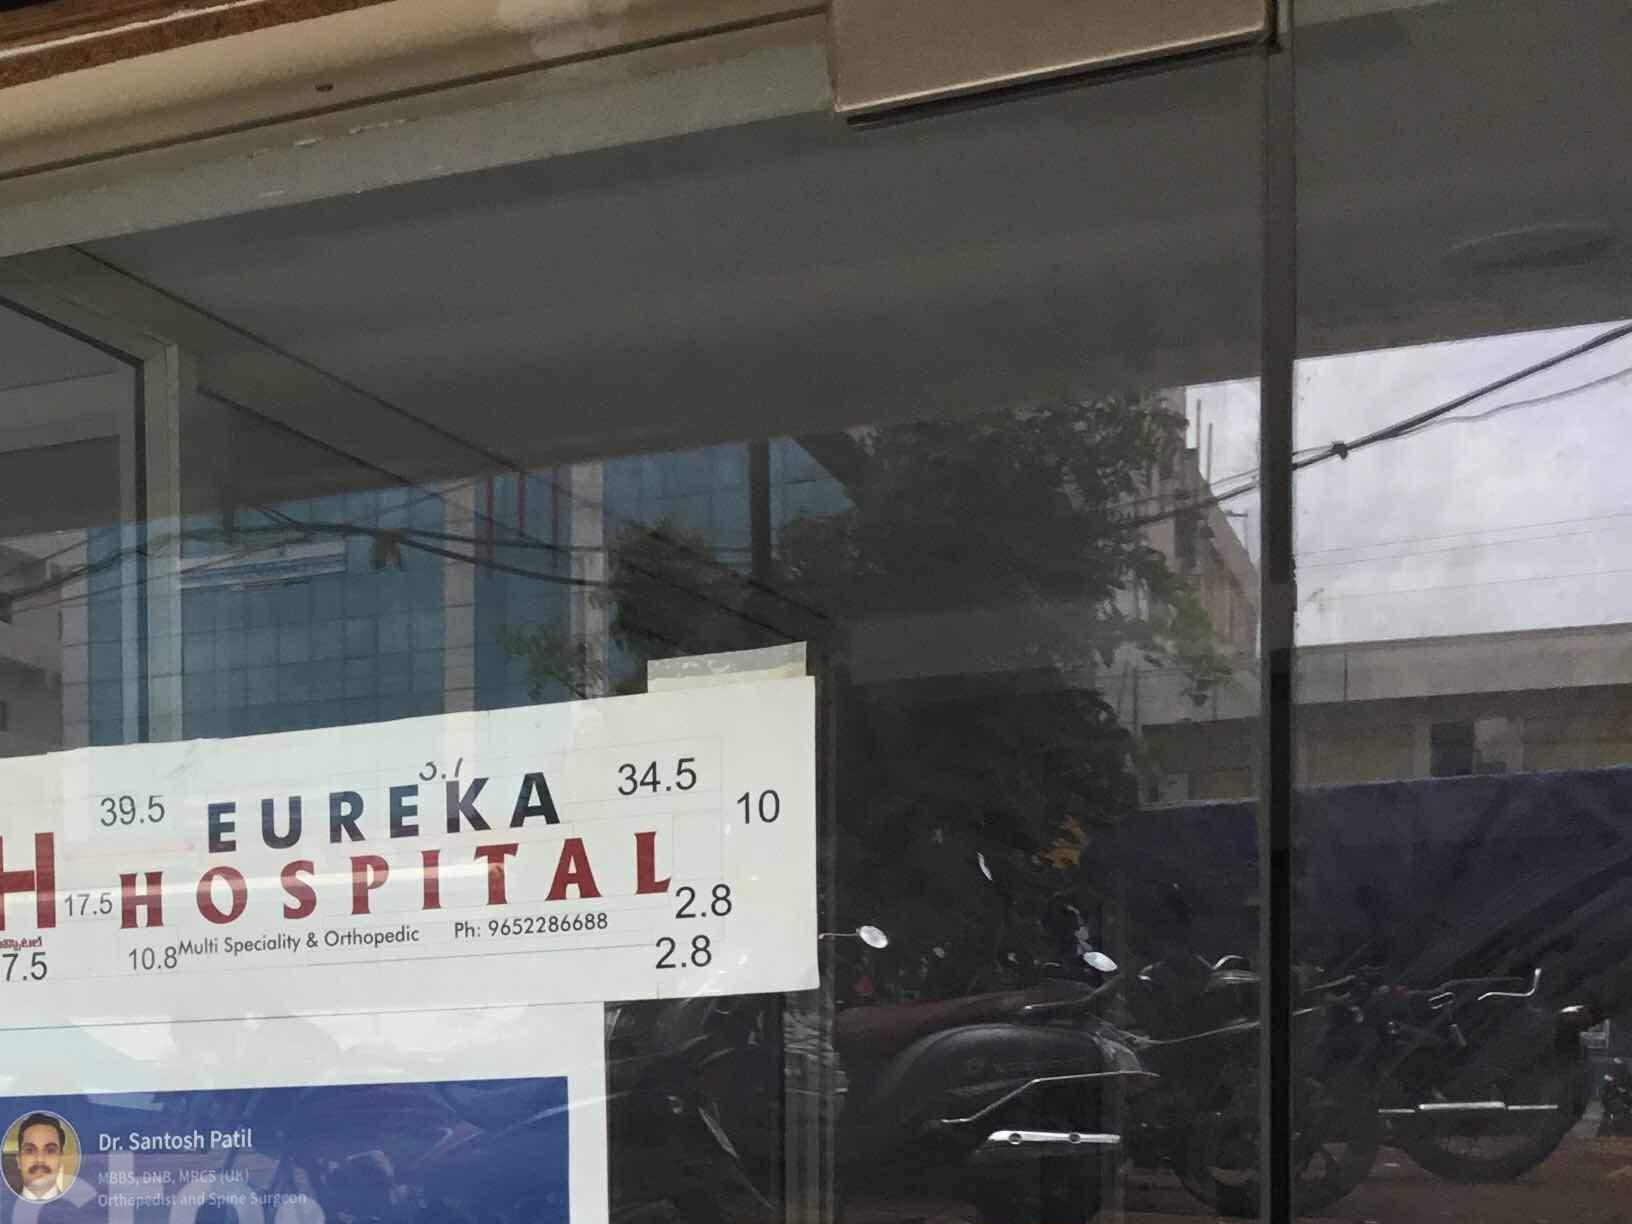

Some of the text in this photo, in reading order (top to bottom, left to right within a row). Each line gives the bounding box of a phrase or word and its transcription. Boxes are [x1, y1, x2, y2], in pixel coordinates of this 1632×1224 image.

[618, 757, 697, 796] 34.5
[100, 795, 166, 827] 39.5
[208, 772, 561, 853] EUREKA
[736, 790, 780, 824] 10
[119, 830, 672, 928] HOSPITAL
[65, 892, 113, 917] 17.5
[674, 883, 733, 919] 2.8
[178, 912, 609, 956] Multi Speciality & Orthopedic Ph: 9652286688
[2, 951, 48, 982] 7.5
[128, 946, 178, 970] 10.8
[655, 935, 712, 970] 2.8
[99, 1128, 253, 1151] Dr. Santosh Patil
[209, 1191, 246, 1209] Spine
[250, 1191, 308, 1209] Surgeon
